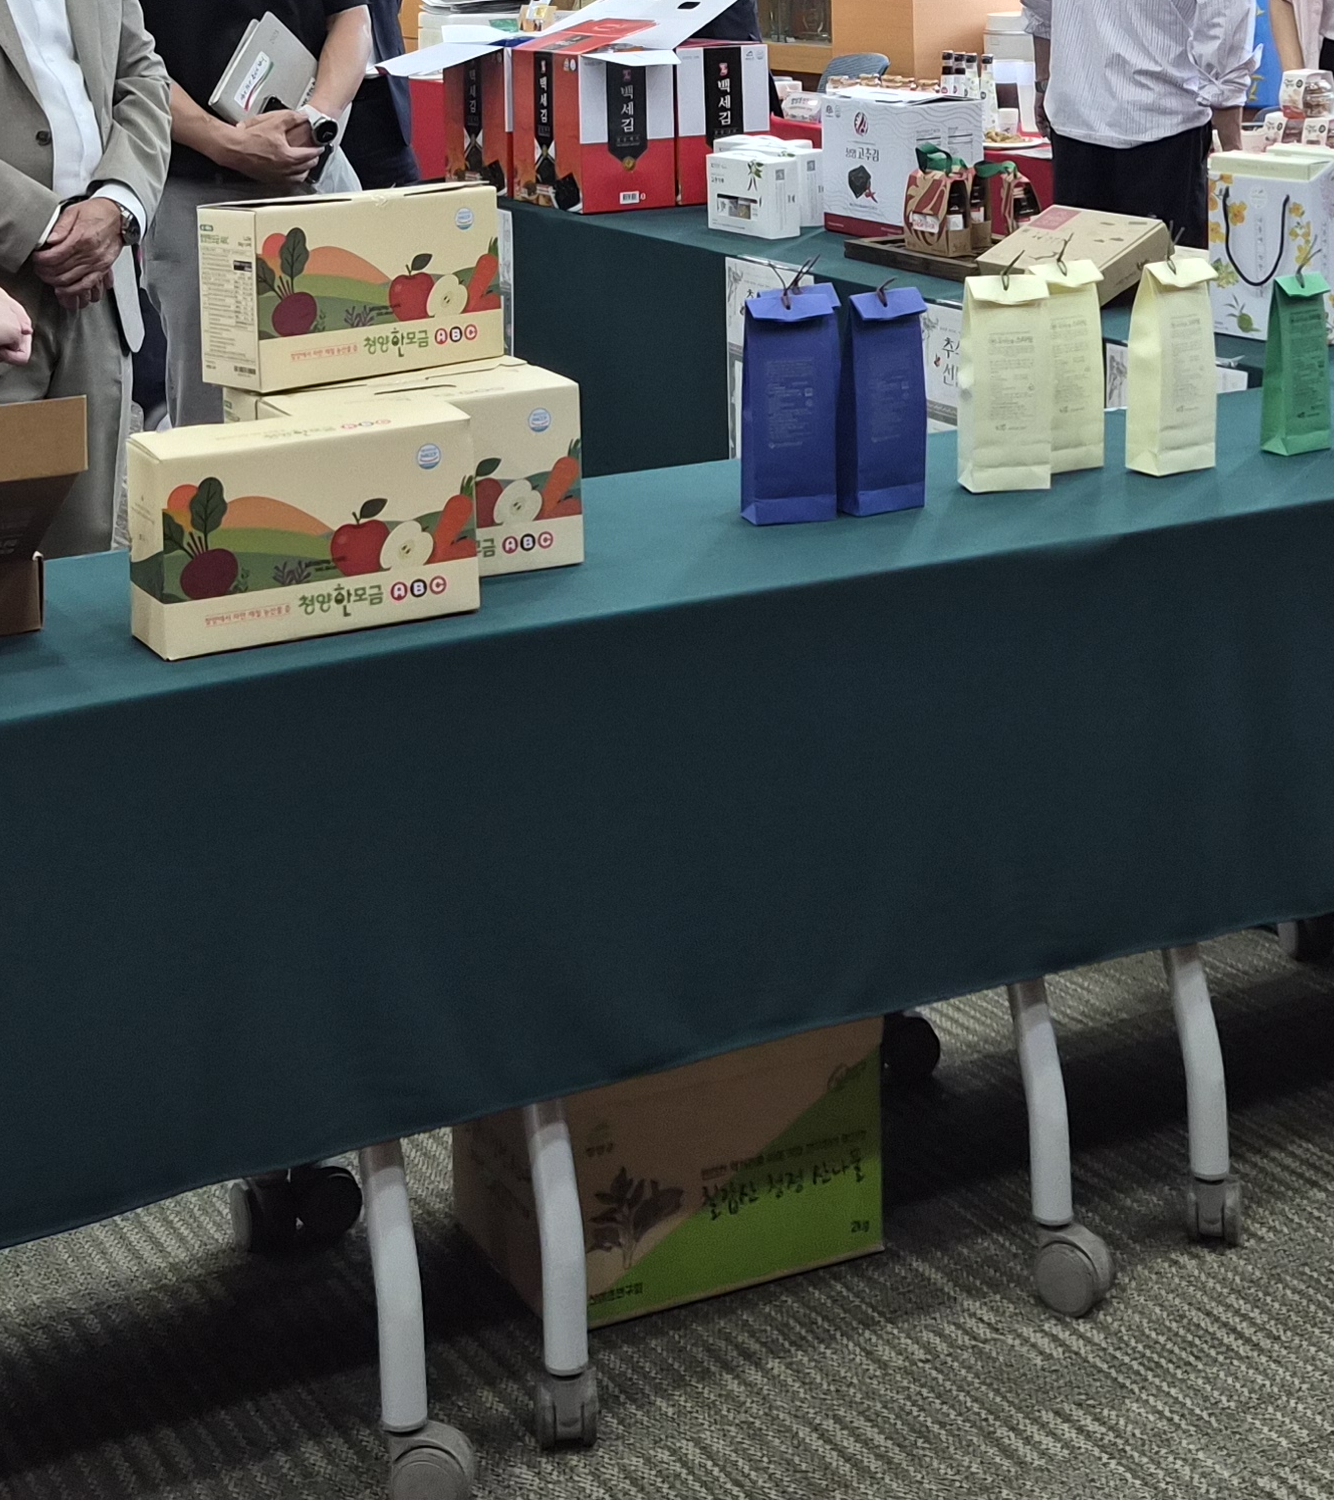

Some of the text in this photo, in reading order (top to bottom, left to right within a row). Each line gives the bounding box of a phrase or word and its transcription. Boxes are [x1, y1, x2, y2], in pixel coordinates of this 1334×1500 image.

[620, 84, 635, 134] 백세김
[717, 77, 732, 126] 백세김
[812, 1148, 865, 1186] 산나물
